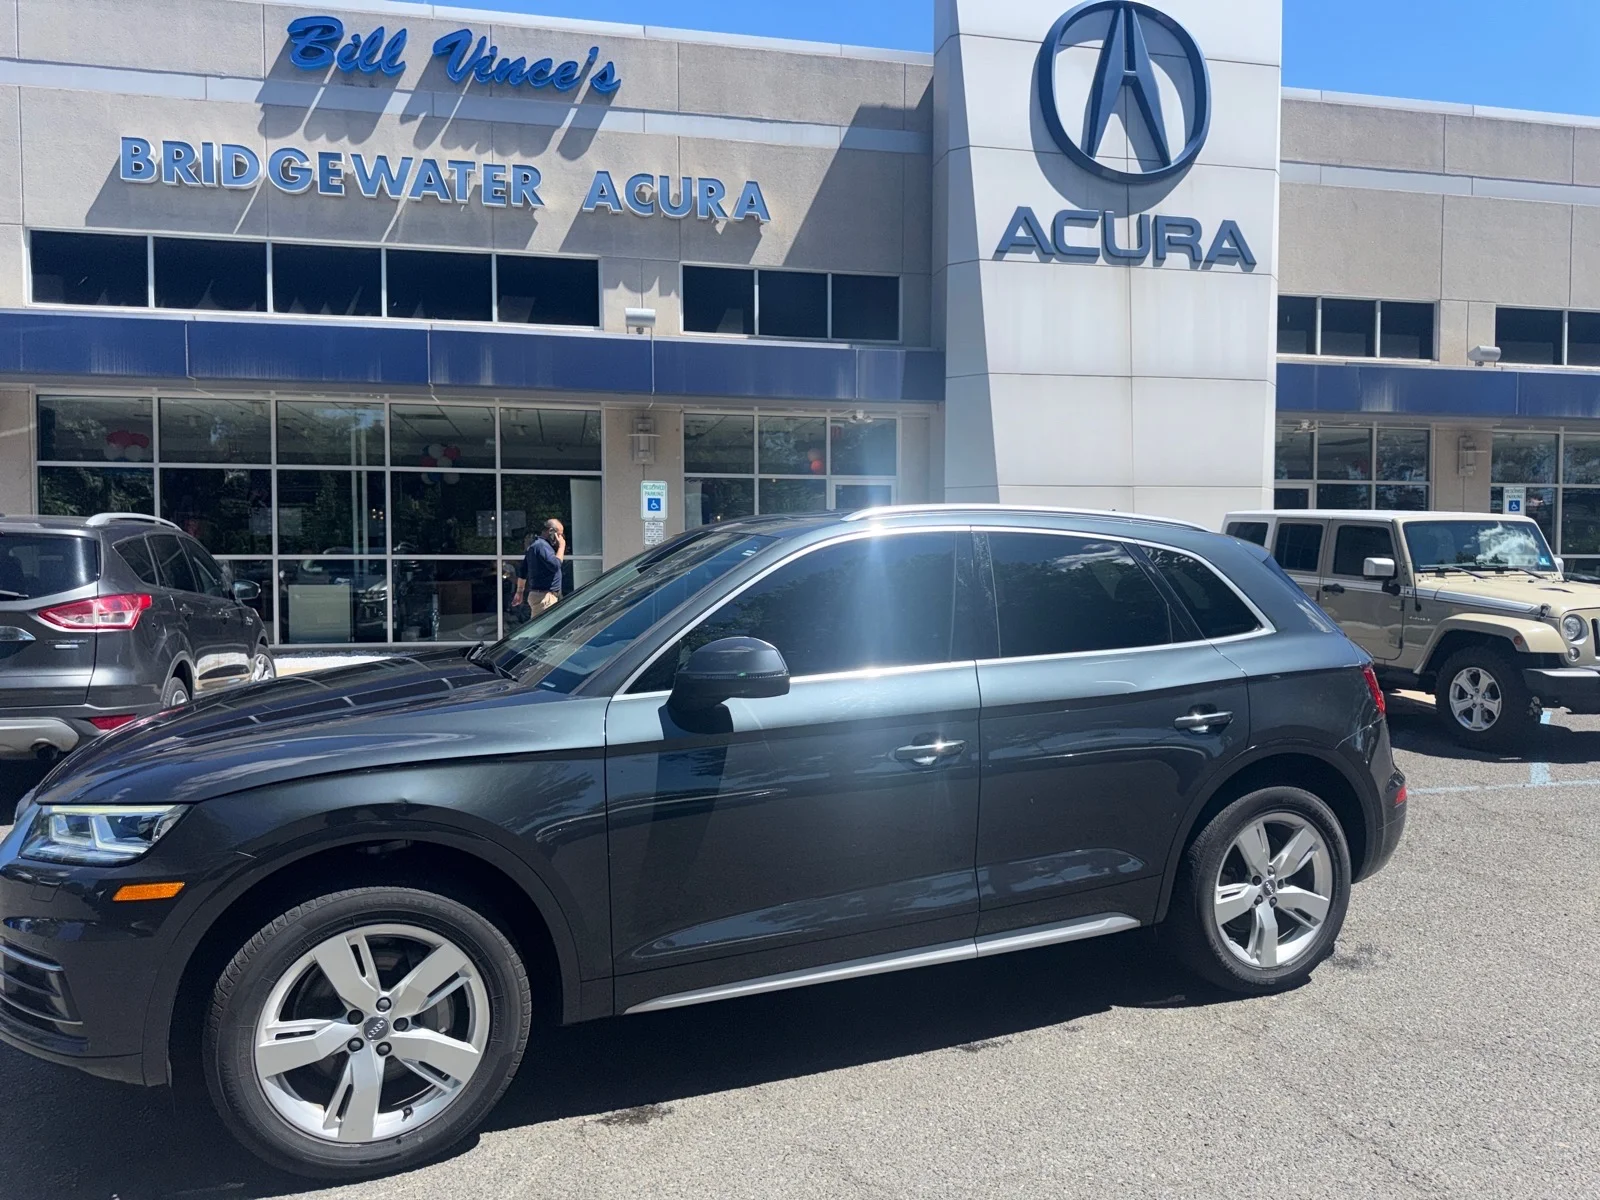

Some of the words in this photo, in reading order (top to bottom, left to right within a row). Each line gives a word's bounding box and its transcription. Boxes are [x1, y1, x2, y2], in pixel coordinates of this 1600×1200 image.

[286, 15, 406, 77] Bill
[432, 28, 622, 95] Vince's
[119, 135, 545, 209] BRIDGEWATER
[581, 169, 772, 223] ACURA
[993, 205, 1257, 267] ACURA
